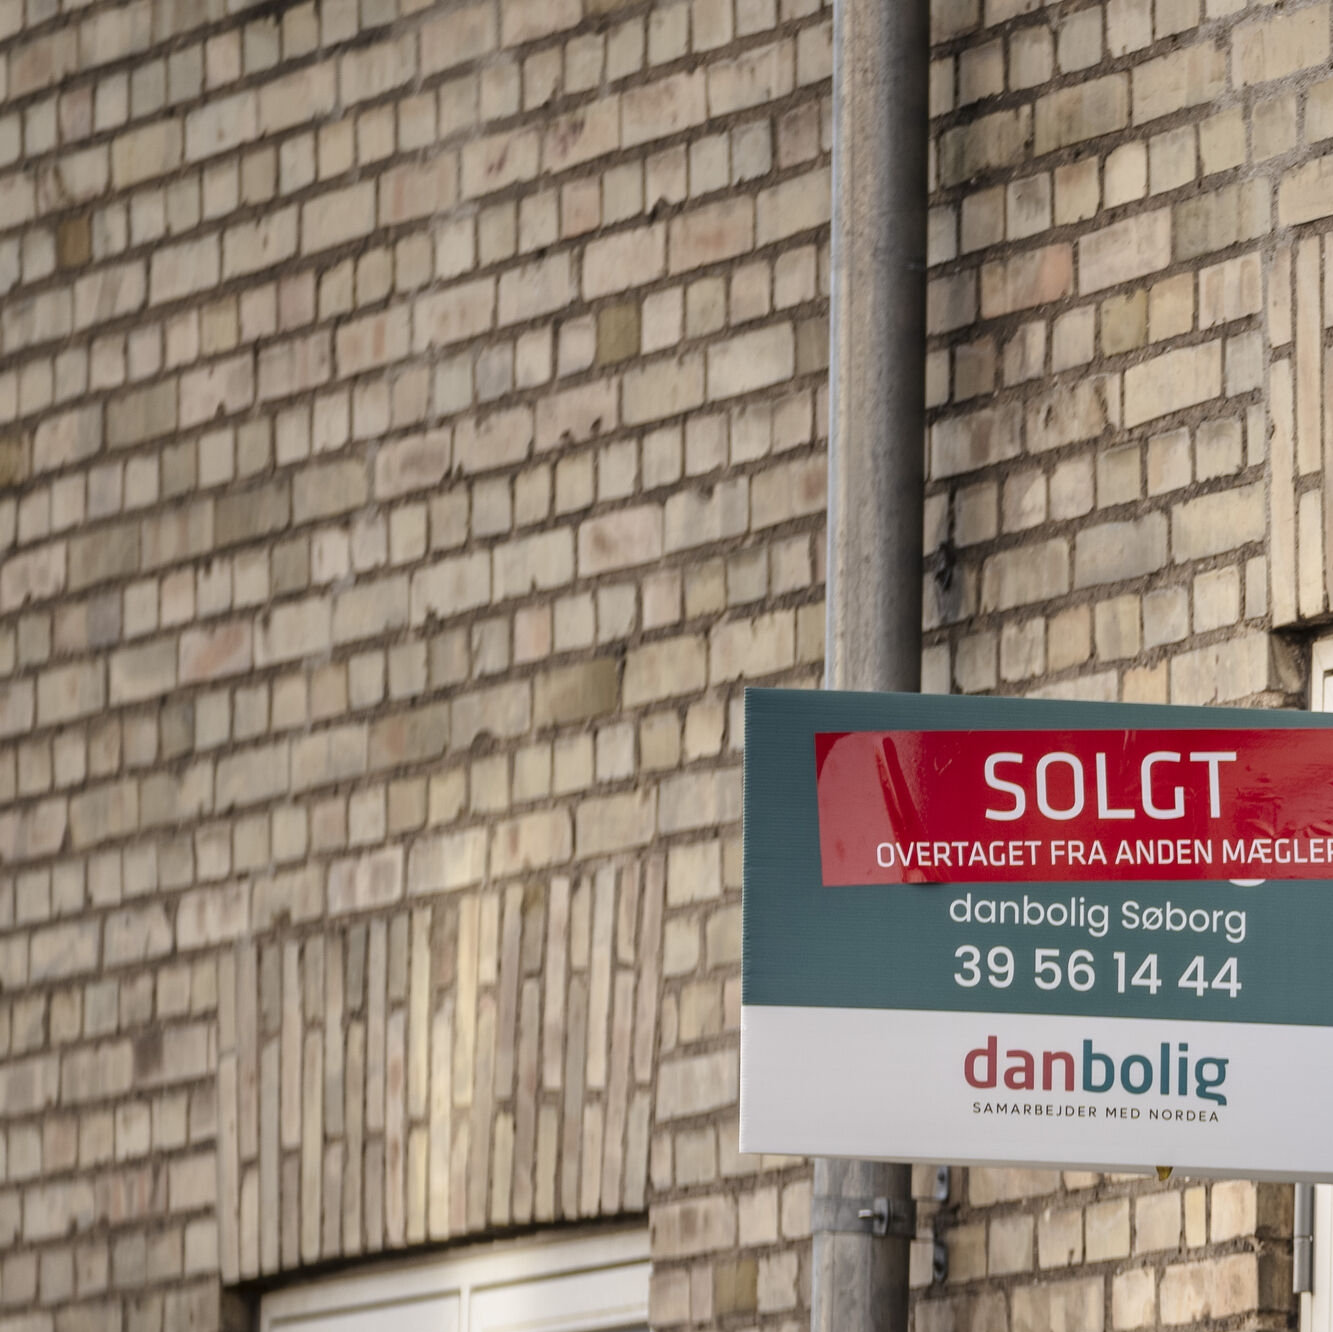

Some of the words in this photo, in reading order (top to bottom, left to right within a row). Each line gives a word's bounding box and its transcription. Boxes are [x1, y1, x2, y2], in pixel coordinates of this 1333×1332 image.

[984, 751, 1237, 821] SOLGT
[876, 840, 1042, 868] OVERTAGET
[1050, 840, 1107, 866] FRA
[1115, 839, 1213, 865] ANDEN
[949, 892, 1109, 938] danbolig
[1121, 900, 1246, 944] Søborg
[954, 944, 1015, 988] 39
[1034, 948, 1096, 992] 56
[1113, 951, 1162, 995] 14
[1177, 955, 1242, 998] 44
[964, 1035, 1230, 1107] danbolig
[972, 1101, 1098, 1118] SAMARBEJDER
[1104, 1106, 1142, 1120] MED
[1149, 1108, 1220, 1123] NORDEA
